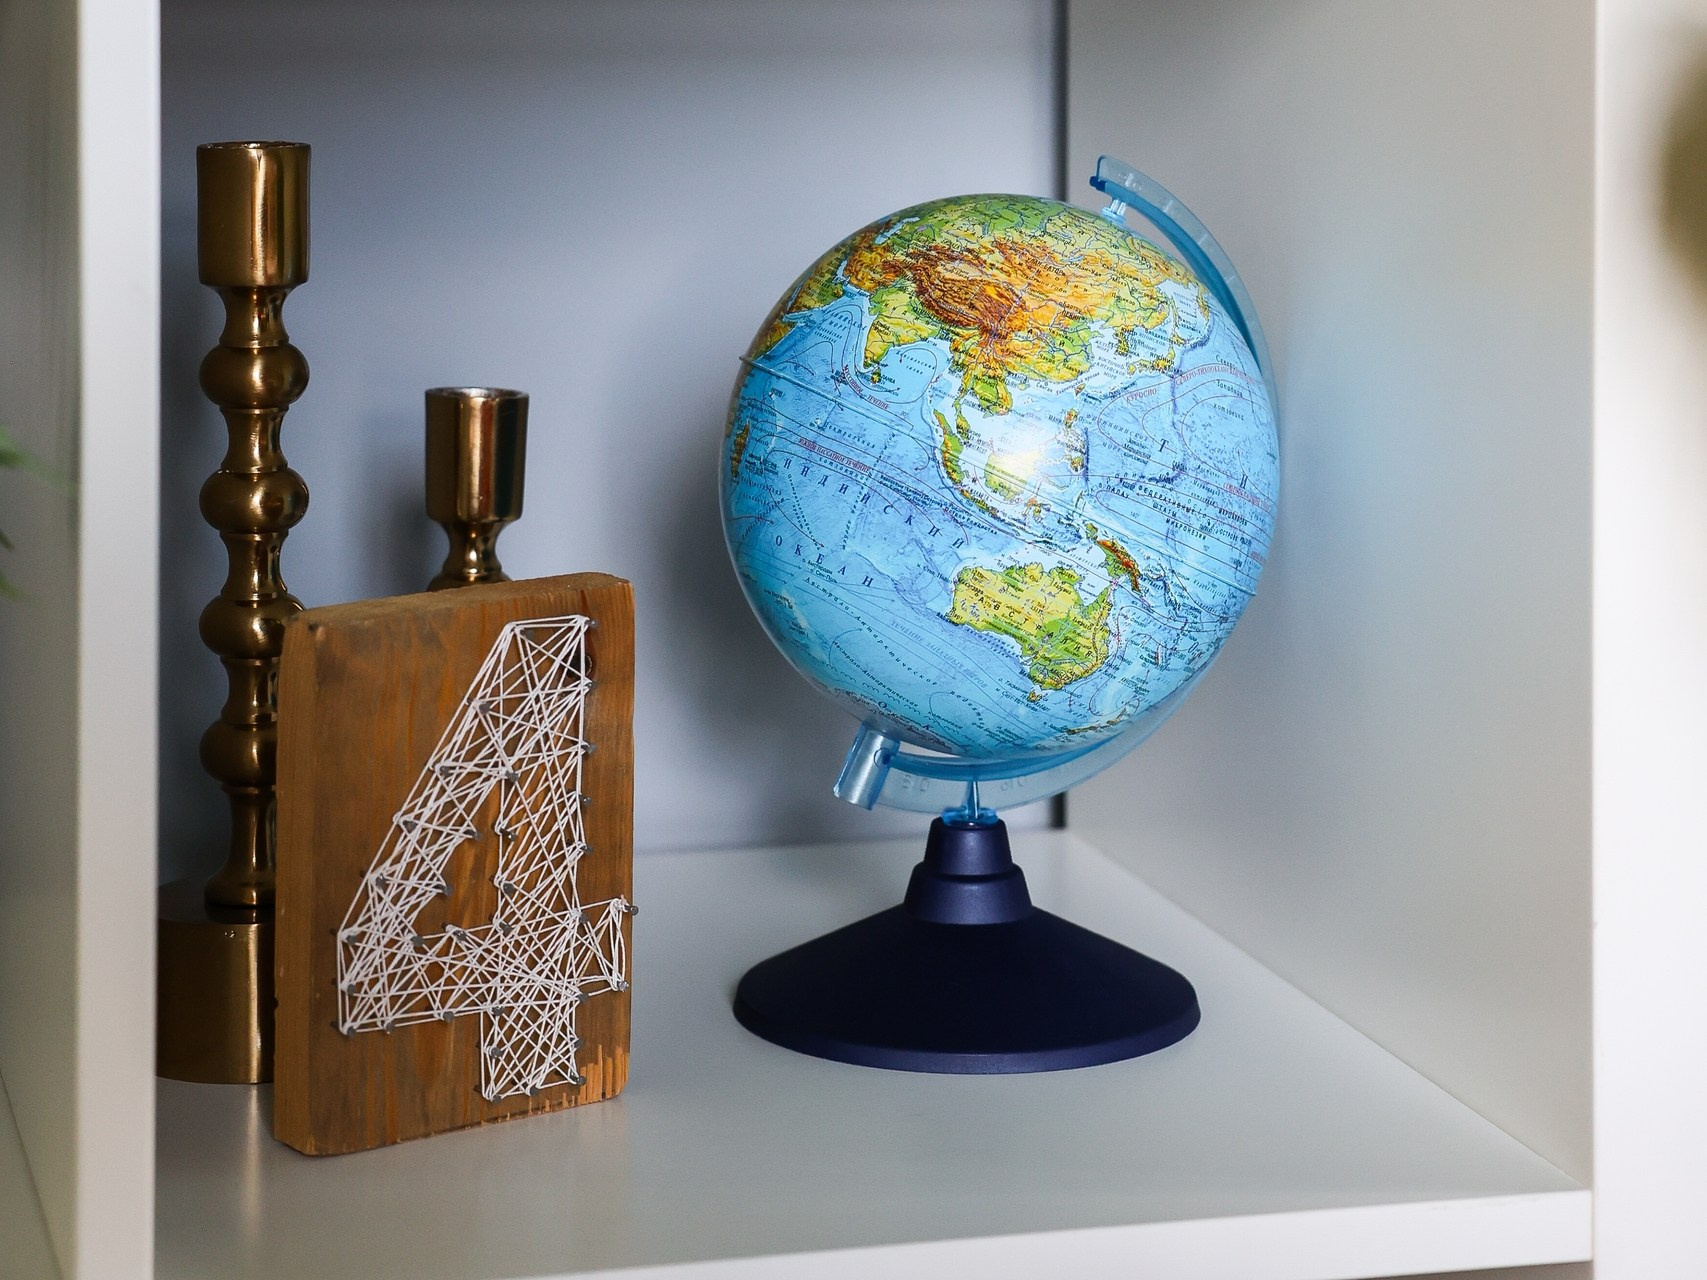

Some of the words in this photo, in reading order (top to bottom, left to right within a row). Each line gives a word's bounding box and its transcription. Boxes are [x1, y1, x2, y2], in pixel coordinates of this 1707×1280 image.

[784, 457, 964, 550] ИНДИЙСКИЙ
[775, 534, 875, 588] ОКЕАН
[977, 596, 1094, 658] АВСТРАЛИЯ
[337, 614, 637, 1103] 4
